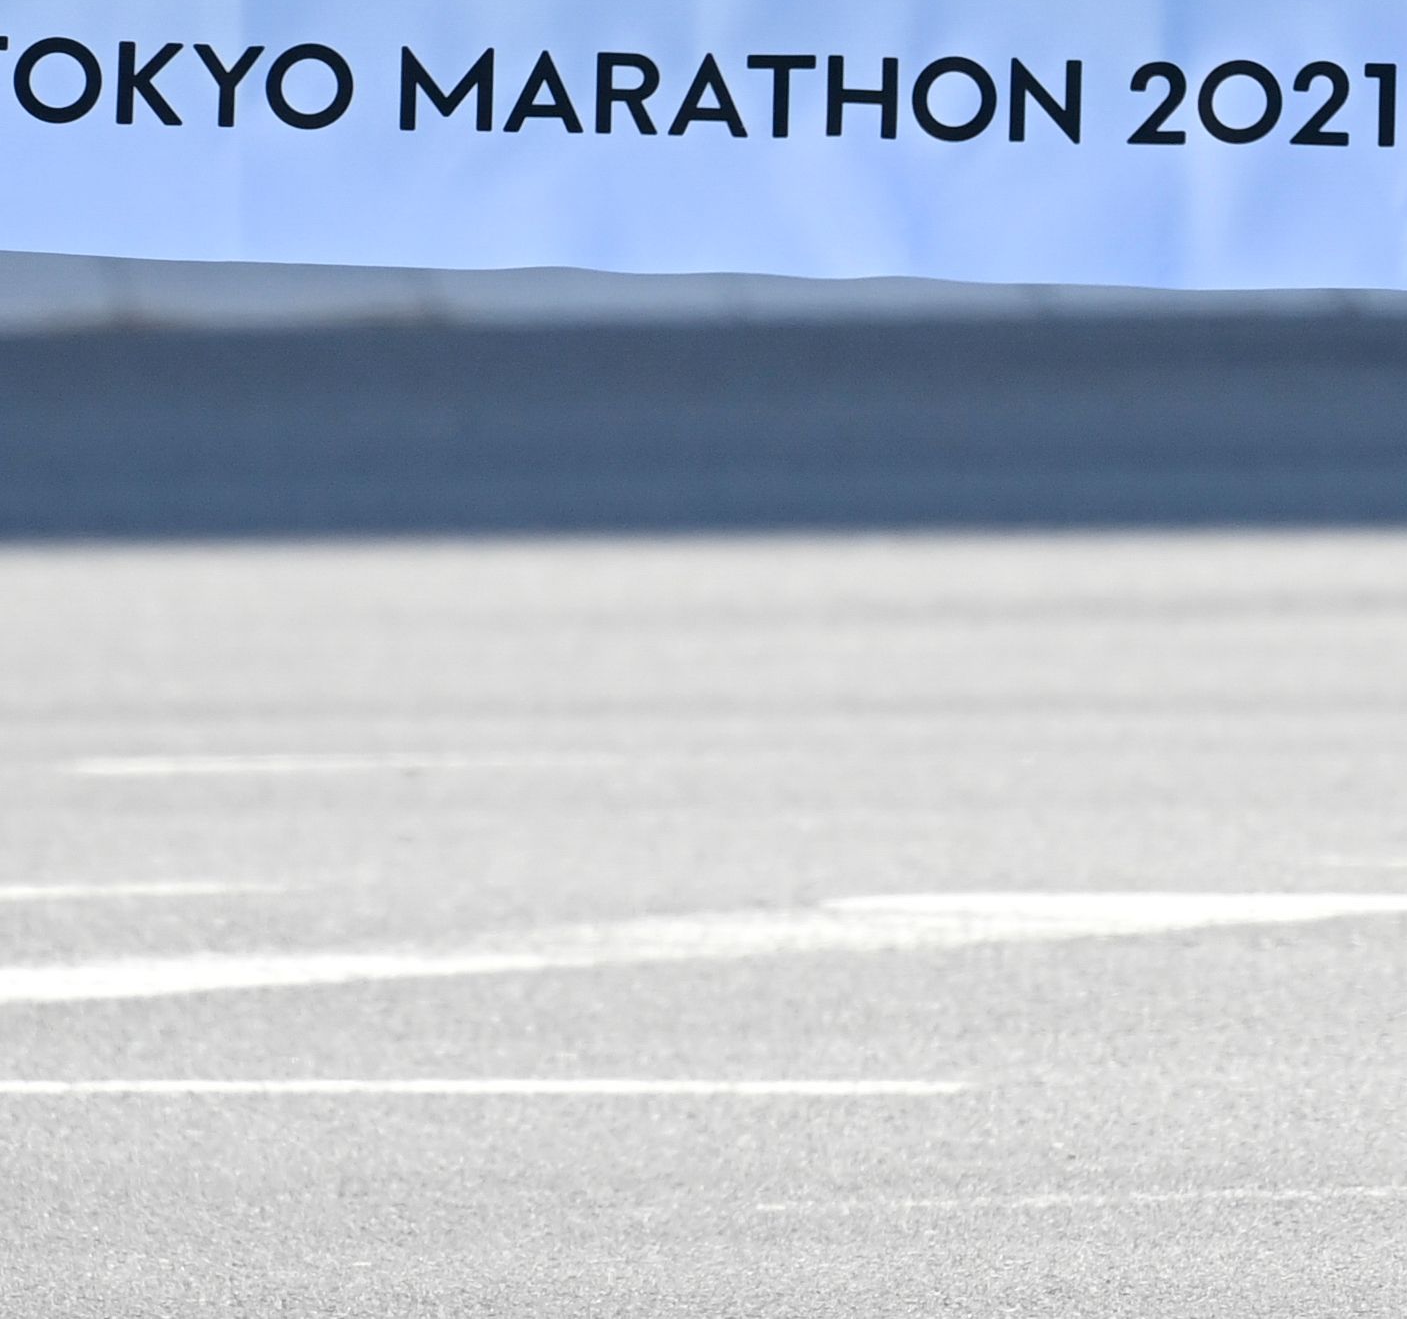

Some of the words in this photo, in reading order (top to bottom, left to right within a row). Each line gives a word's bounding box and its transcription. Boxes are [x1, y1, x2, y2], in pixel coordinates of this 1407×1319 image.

[0, 35, 354, 130] OKYO
[400, 45, 1083, 145] MARATHON
[1126, 59, 1397, 148] 2021
